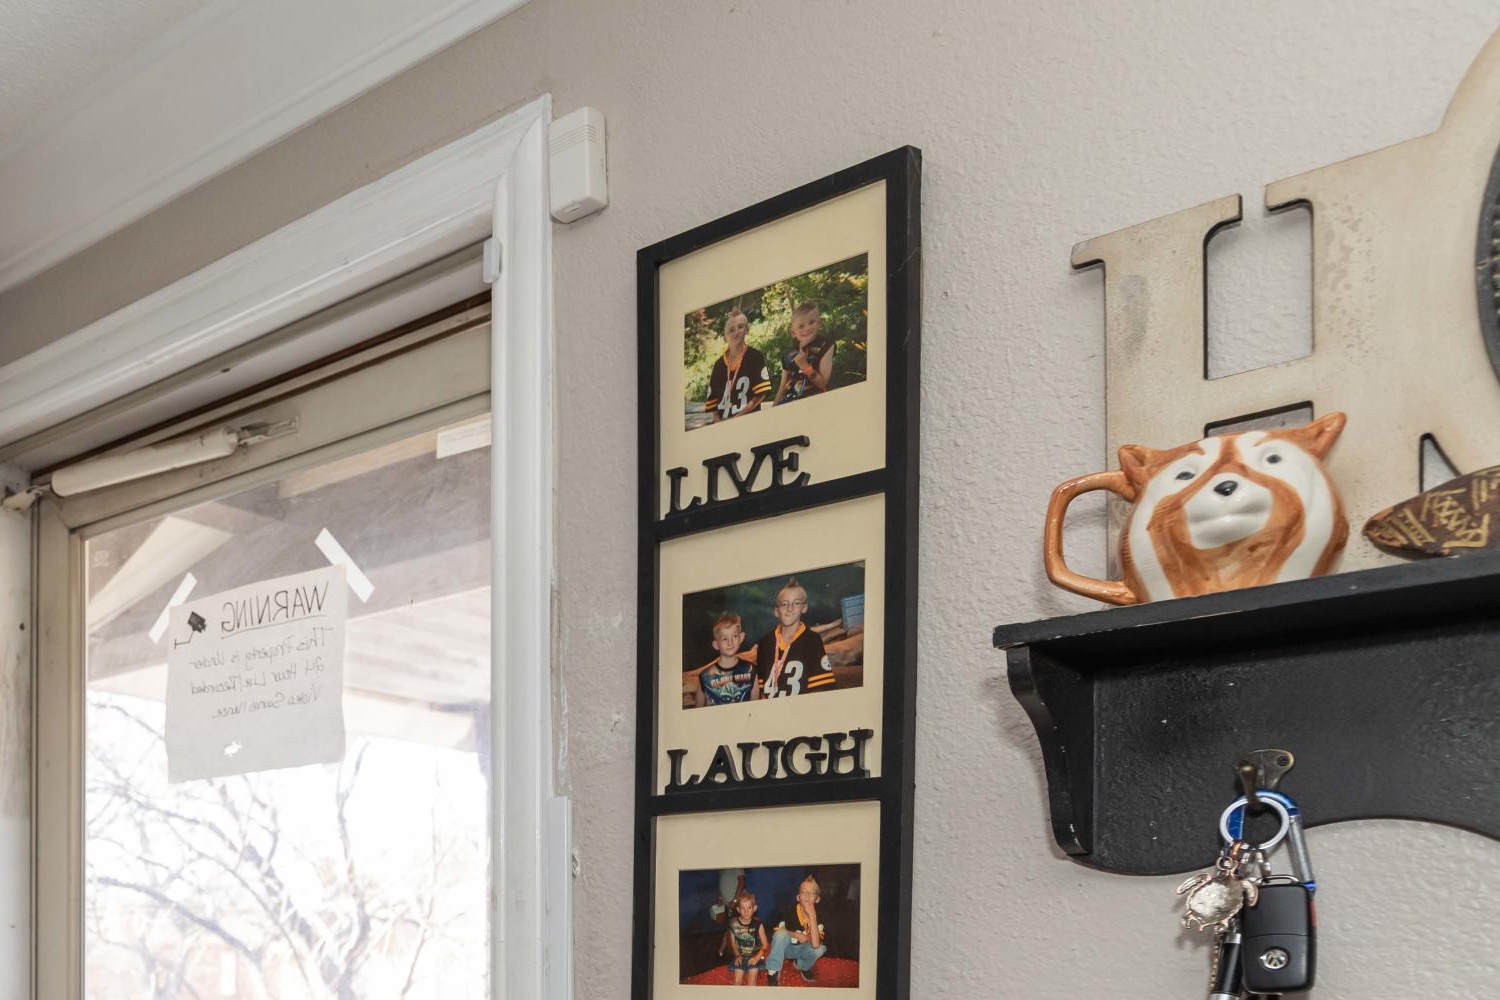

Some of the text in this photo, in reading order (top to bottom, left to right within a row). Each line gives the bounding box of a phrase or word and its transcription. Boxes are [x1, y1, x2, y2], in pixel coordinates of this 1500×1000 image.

[665, 435, 810, 518] LIVE
[762, 660, 804, 699] 43
[665, 727, 874, 795] LAUGH
